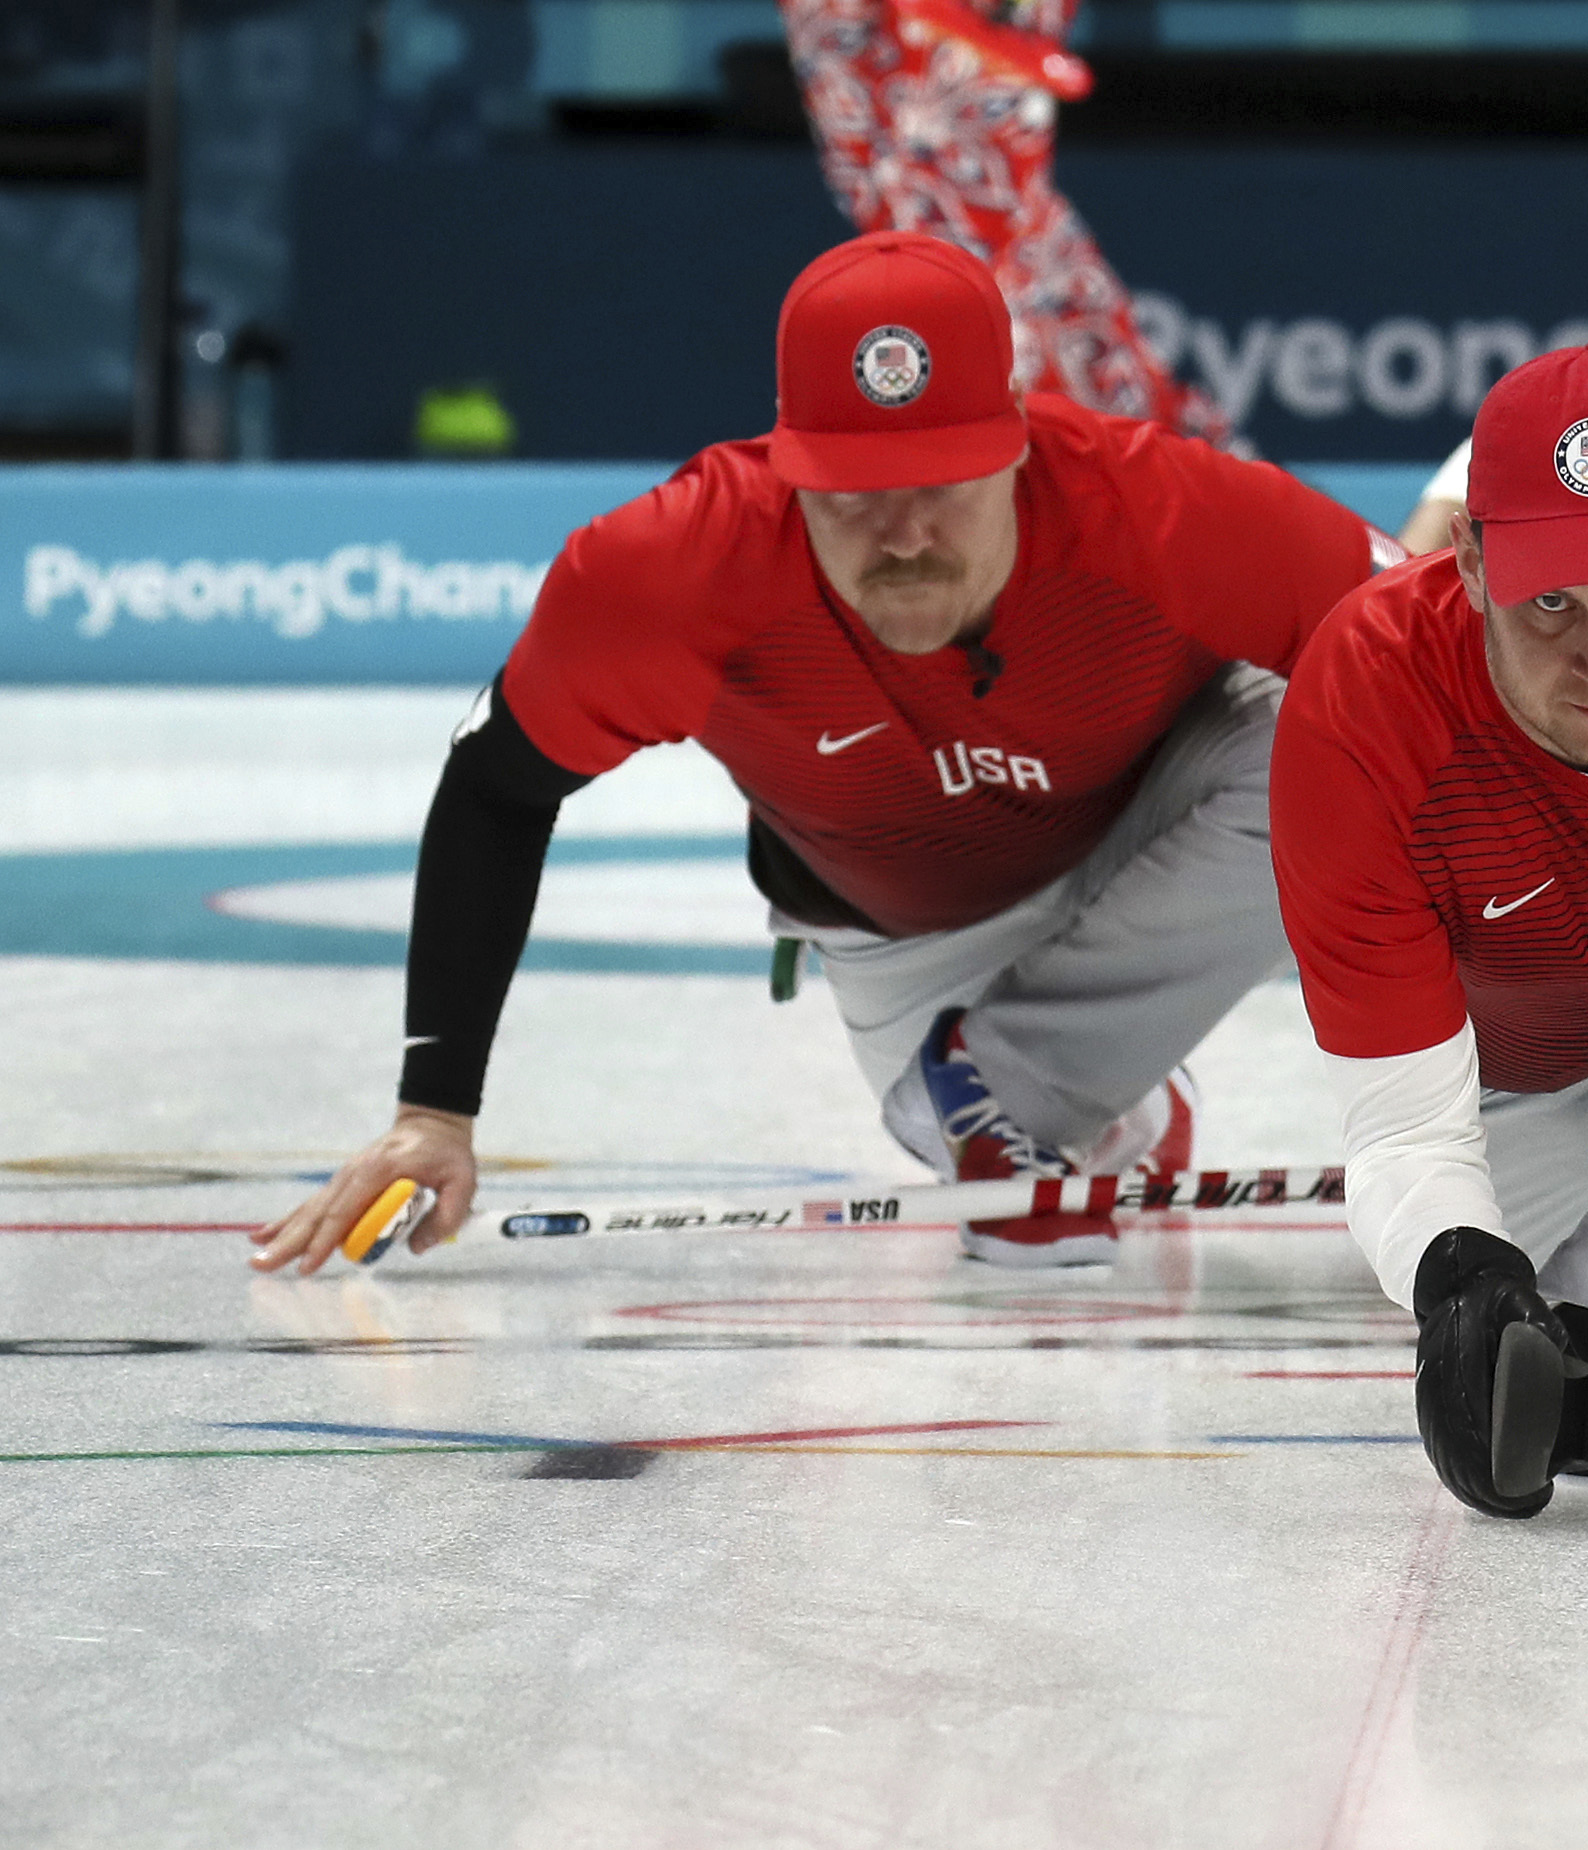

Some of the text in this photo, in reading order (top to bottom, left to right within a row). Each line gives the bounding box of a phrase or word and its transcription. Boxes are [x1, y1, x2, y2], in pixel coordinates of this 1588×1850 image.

[25, 543, 550, 637] PyeongChan
[933, 740, 1051, 796] USA
[849, 1199, 899, 1221] USA
[1117, 1179, 1346, 1207] ardline
